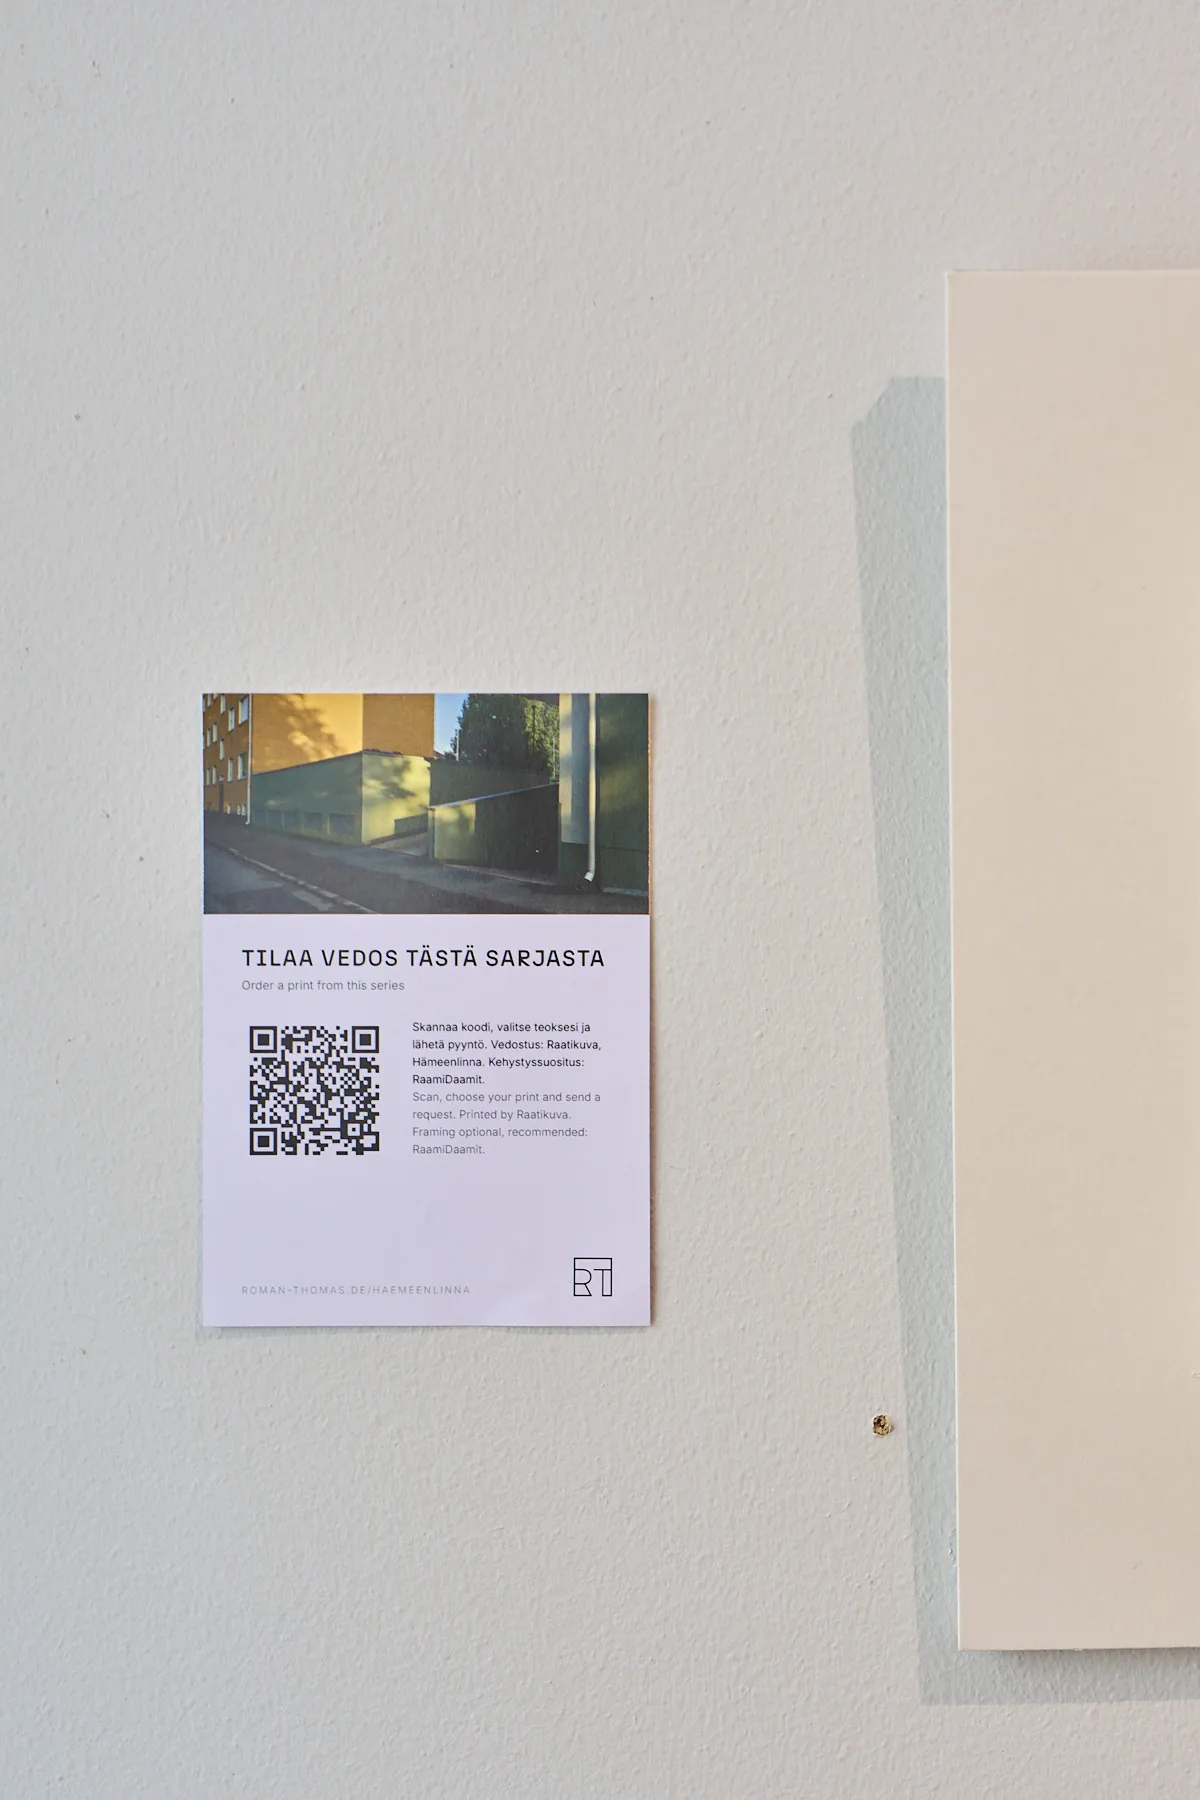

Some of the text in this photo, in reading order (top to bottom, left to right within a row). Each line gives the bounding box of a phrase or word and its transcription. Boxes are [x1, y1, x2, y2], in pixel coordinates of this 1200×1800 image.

[241, 944, 605, 967] TILAA VEDOS TÄSTÄ SARJASTA
[241, 979, 405, 993] Order a print from this series
[412, 1021, 591, 1035] Skannaa koodi, valitse teoksesi ja
[412, 1039, 602, 1052] lähetä pyyntö. Vedostus: Raatikuva,
[412, 1056, 585, 1070] Hämeenlinna. Kehystyssuositus:
[412, 1074, 486, 1085] RaamiDaamit.
[411, 1091, 601, 1105] Scan, choose your print and send a
[412, 1108, 572, 1122] request. Printed by Raatikuva.
[412, 1126, 588, 1140] Framing optional, recommended:
[412, 1143, 486, 1155] RaamiDaamit.
[573, 1257, 612, 1297] RT
[241, 1285, 470, 1296] ROMAN-THOMAS.DE/HAEMEENLINNA
